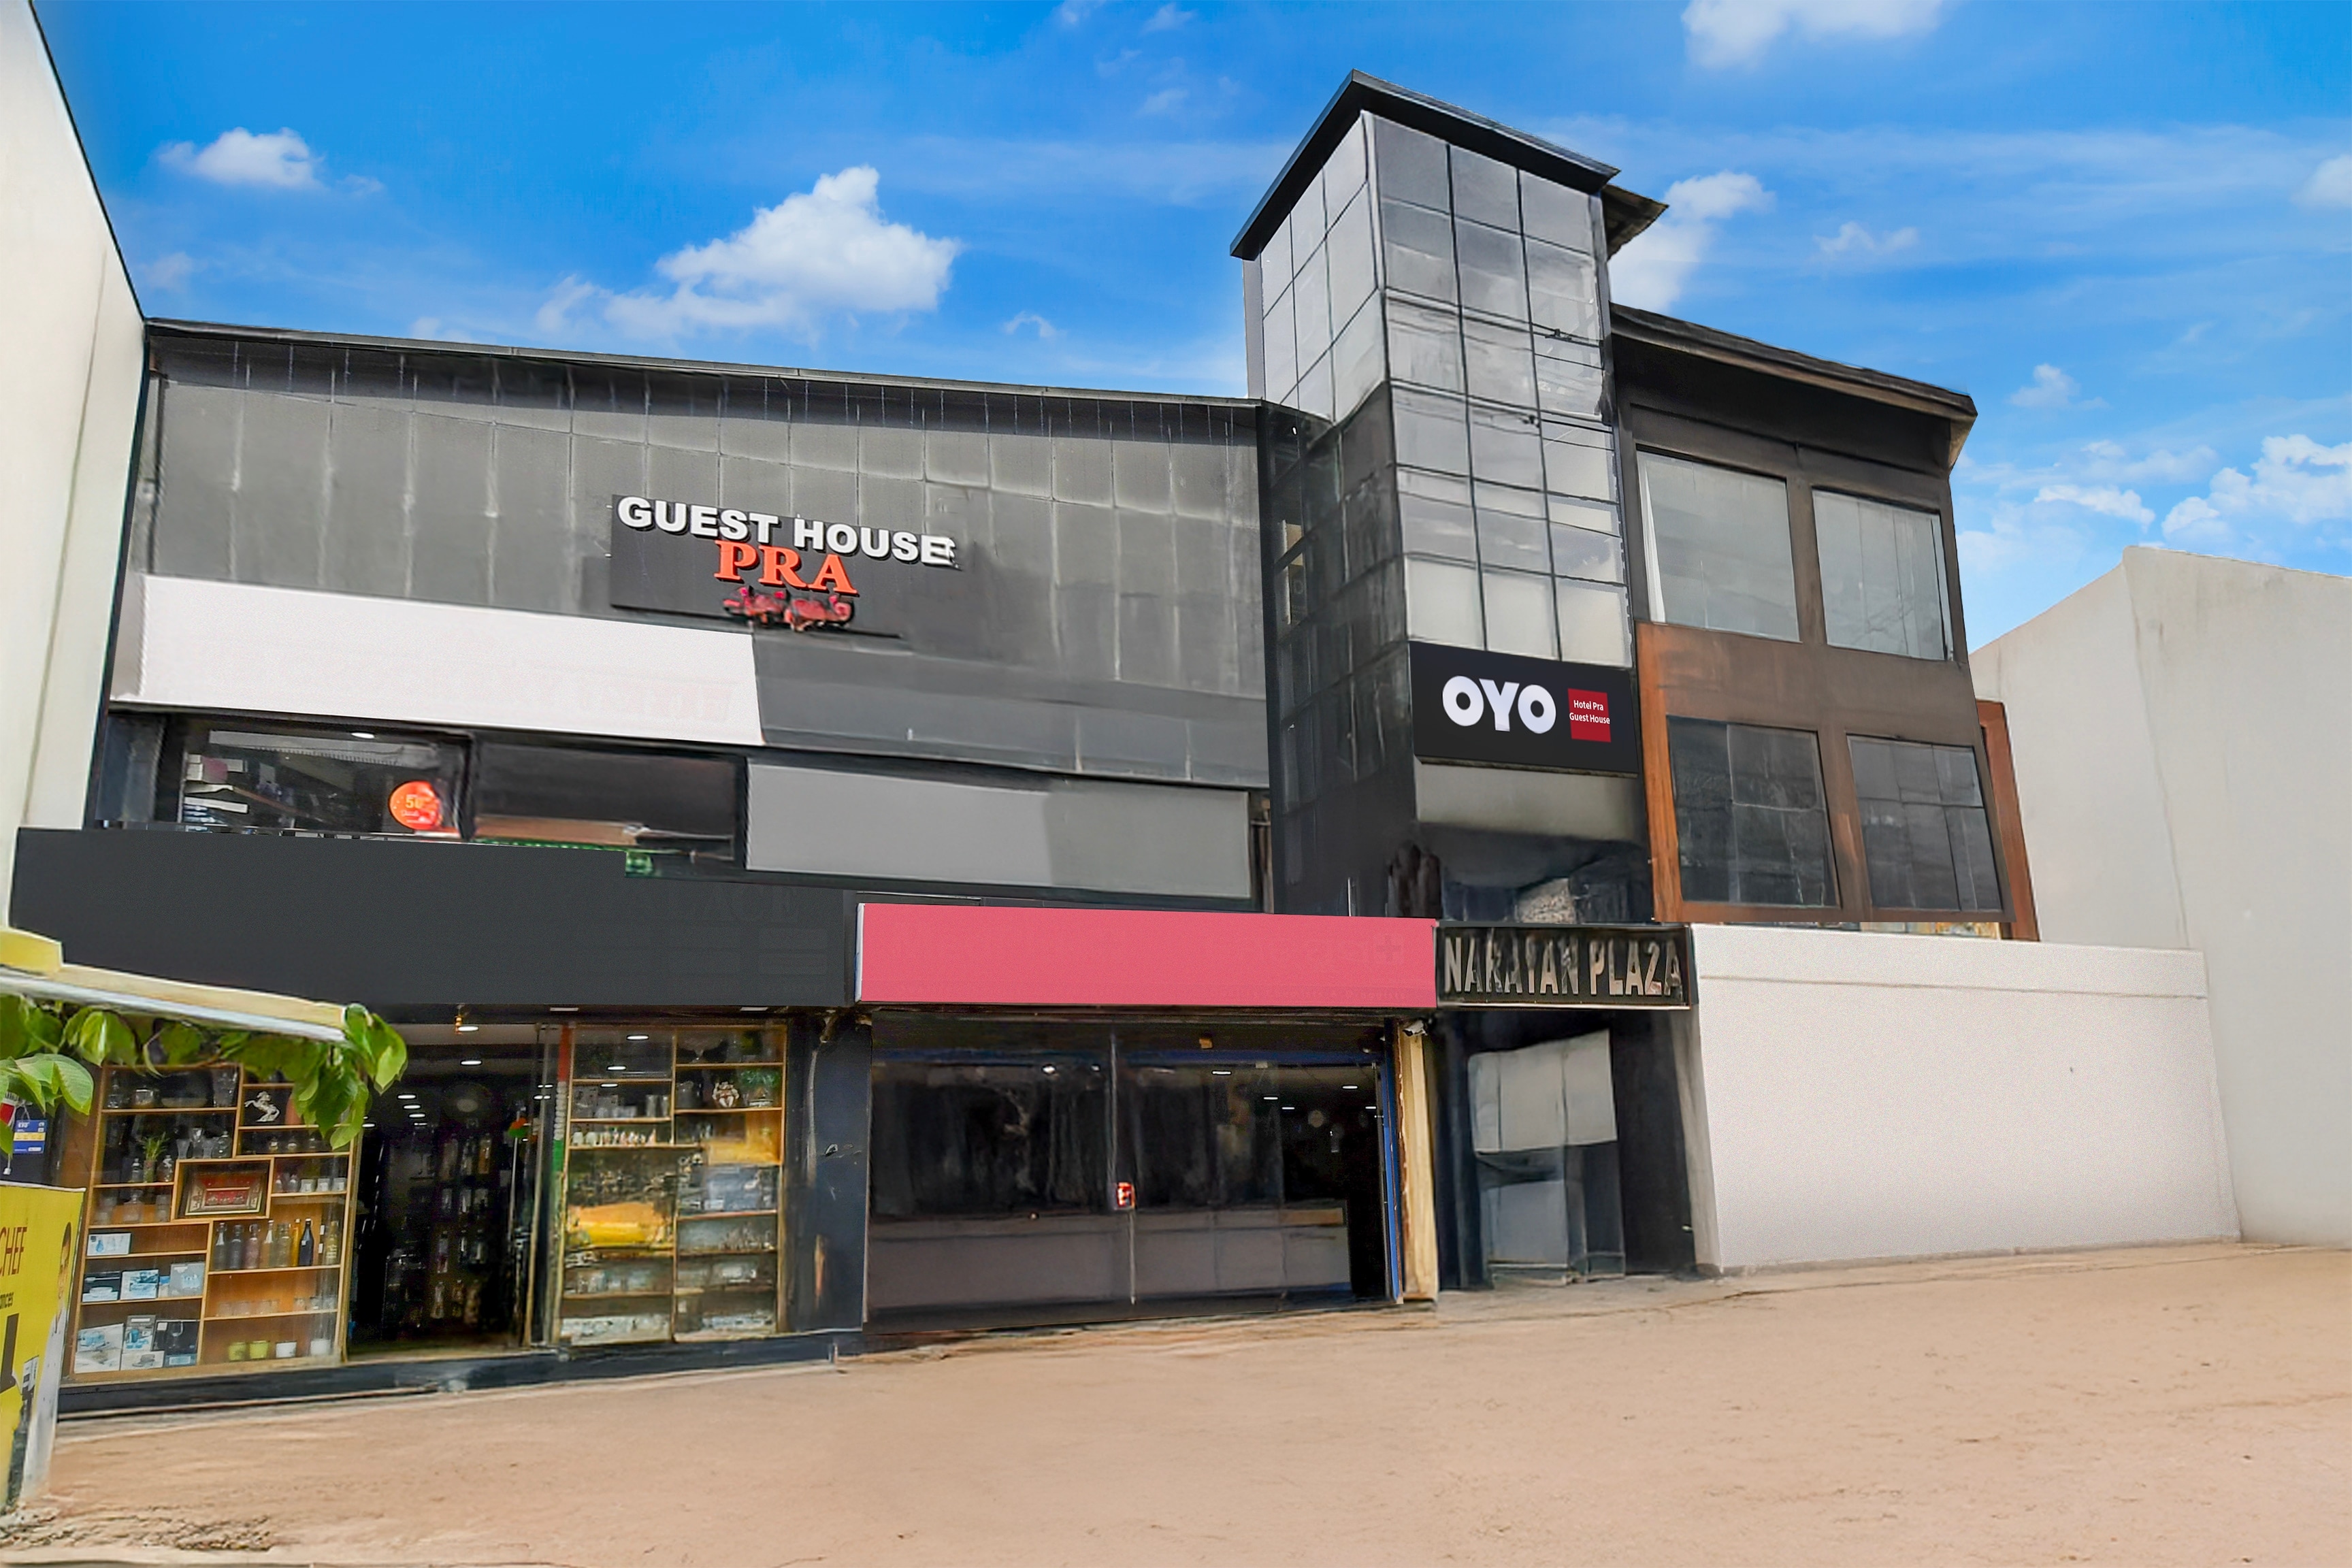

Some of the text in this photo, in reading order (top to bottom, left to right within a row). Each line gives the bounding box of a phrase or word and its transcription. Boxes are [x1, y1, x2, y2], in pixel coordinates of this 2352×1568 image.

[617, 496, 957, 568] GUEST HOUSE
[713, 539, 860, 595] PRA
[1441, 675, 1556, 734] OYO
[1569, 712, 1611, 725] Guest House
[1573, 700, 1604, 711] Hotel Pra
[1588, 936, 1684, 998] PLAZA
